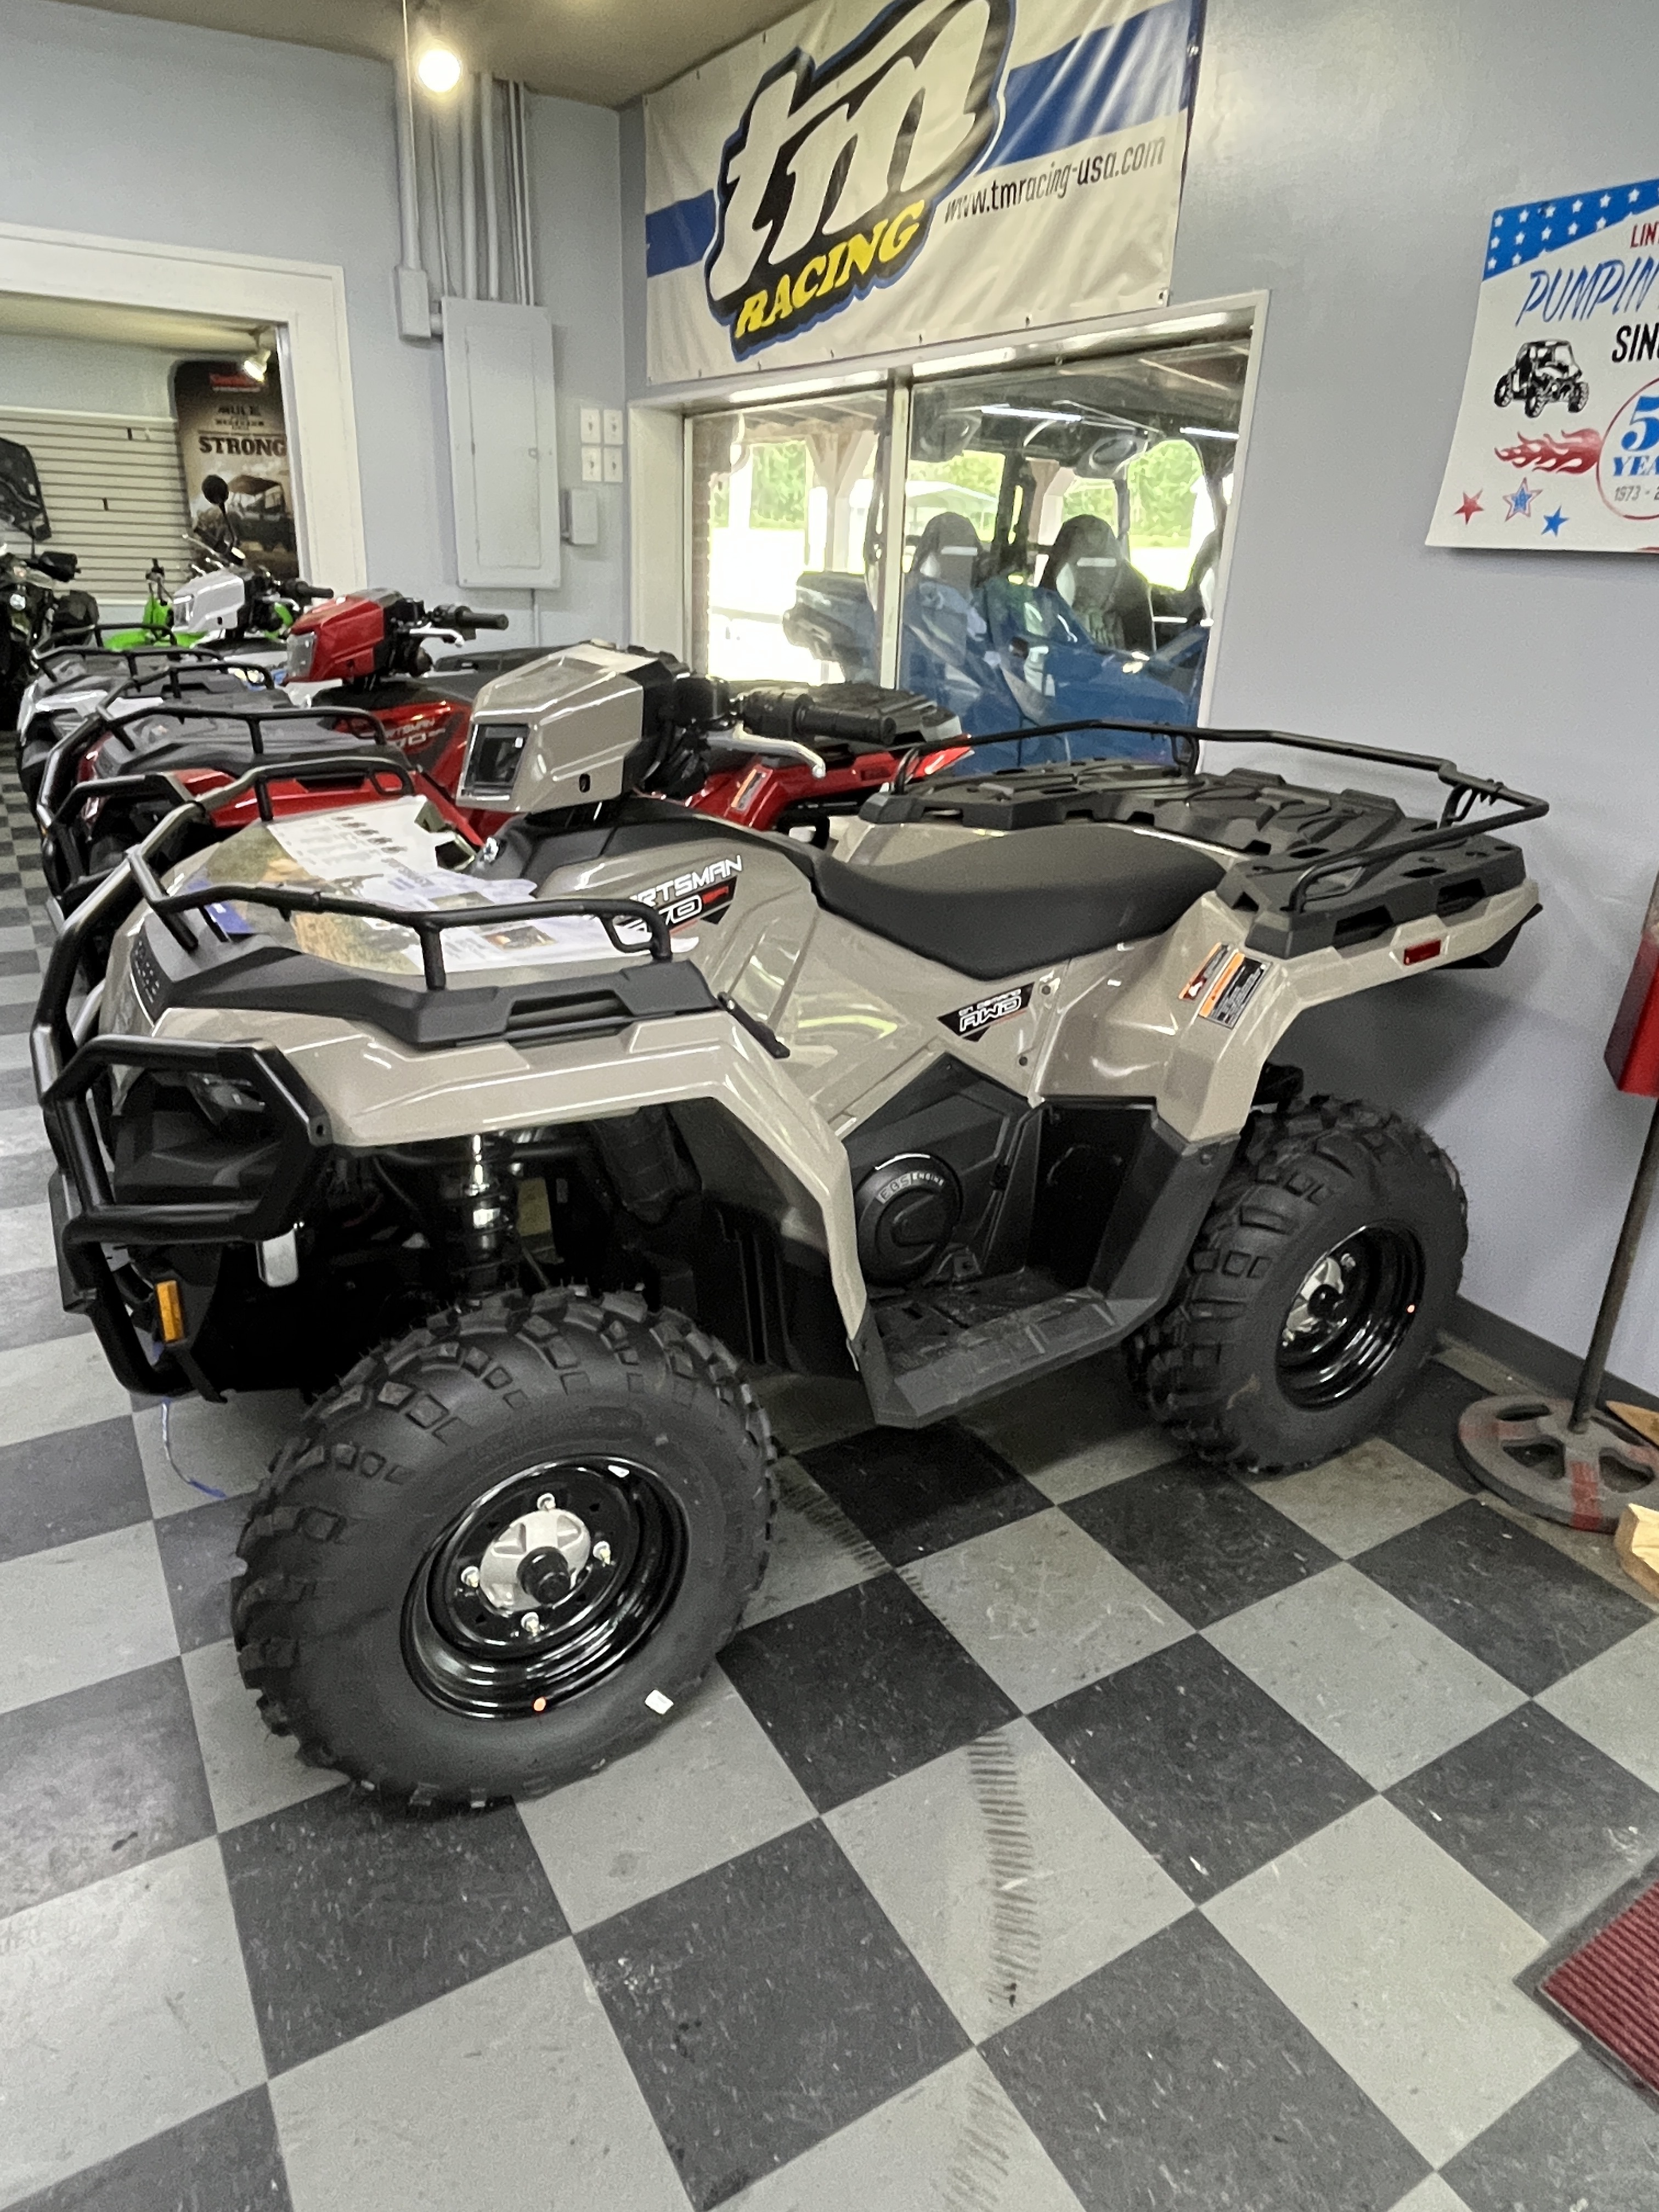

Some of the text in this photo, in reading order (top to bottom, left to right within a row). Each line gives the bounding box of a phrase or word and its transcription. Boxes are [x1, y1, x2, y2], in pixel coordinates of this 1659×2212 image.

[709, 0, 990, 301] tm
[944, 136, 1166, 224] www.tmracing-usa.com
[1630, 221, 1659, 249] LIN
[735, 200, 925, 338] RACING
[1611, 322, 1659, 363] SIN
[199, 436, 287, 456] STRONG
[1614, 485, 1641, 502] 1973
[629, 854, 743, 907] RTSMAN
[960, 995, 1022, 1032] AWD
